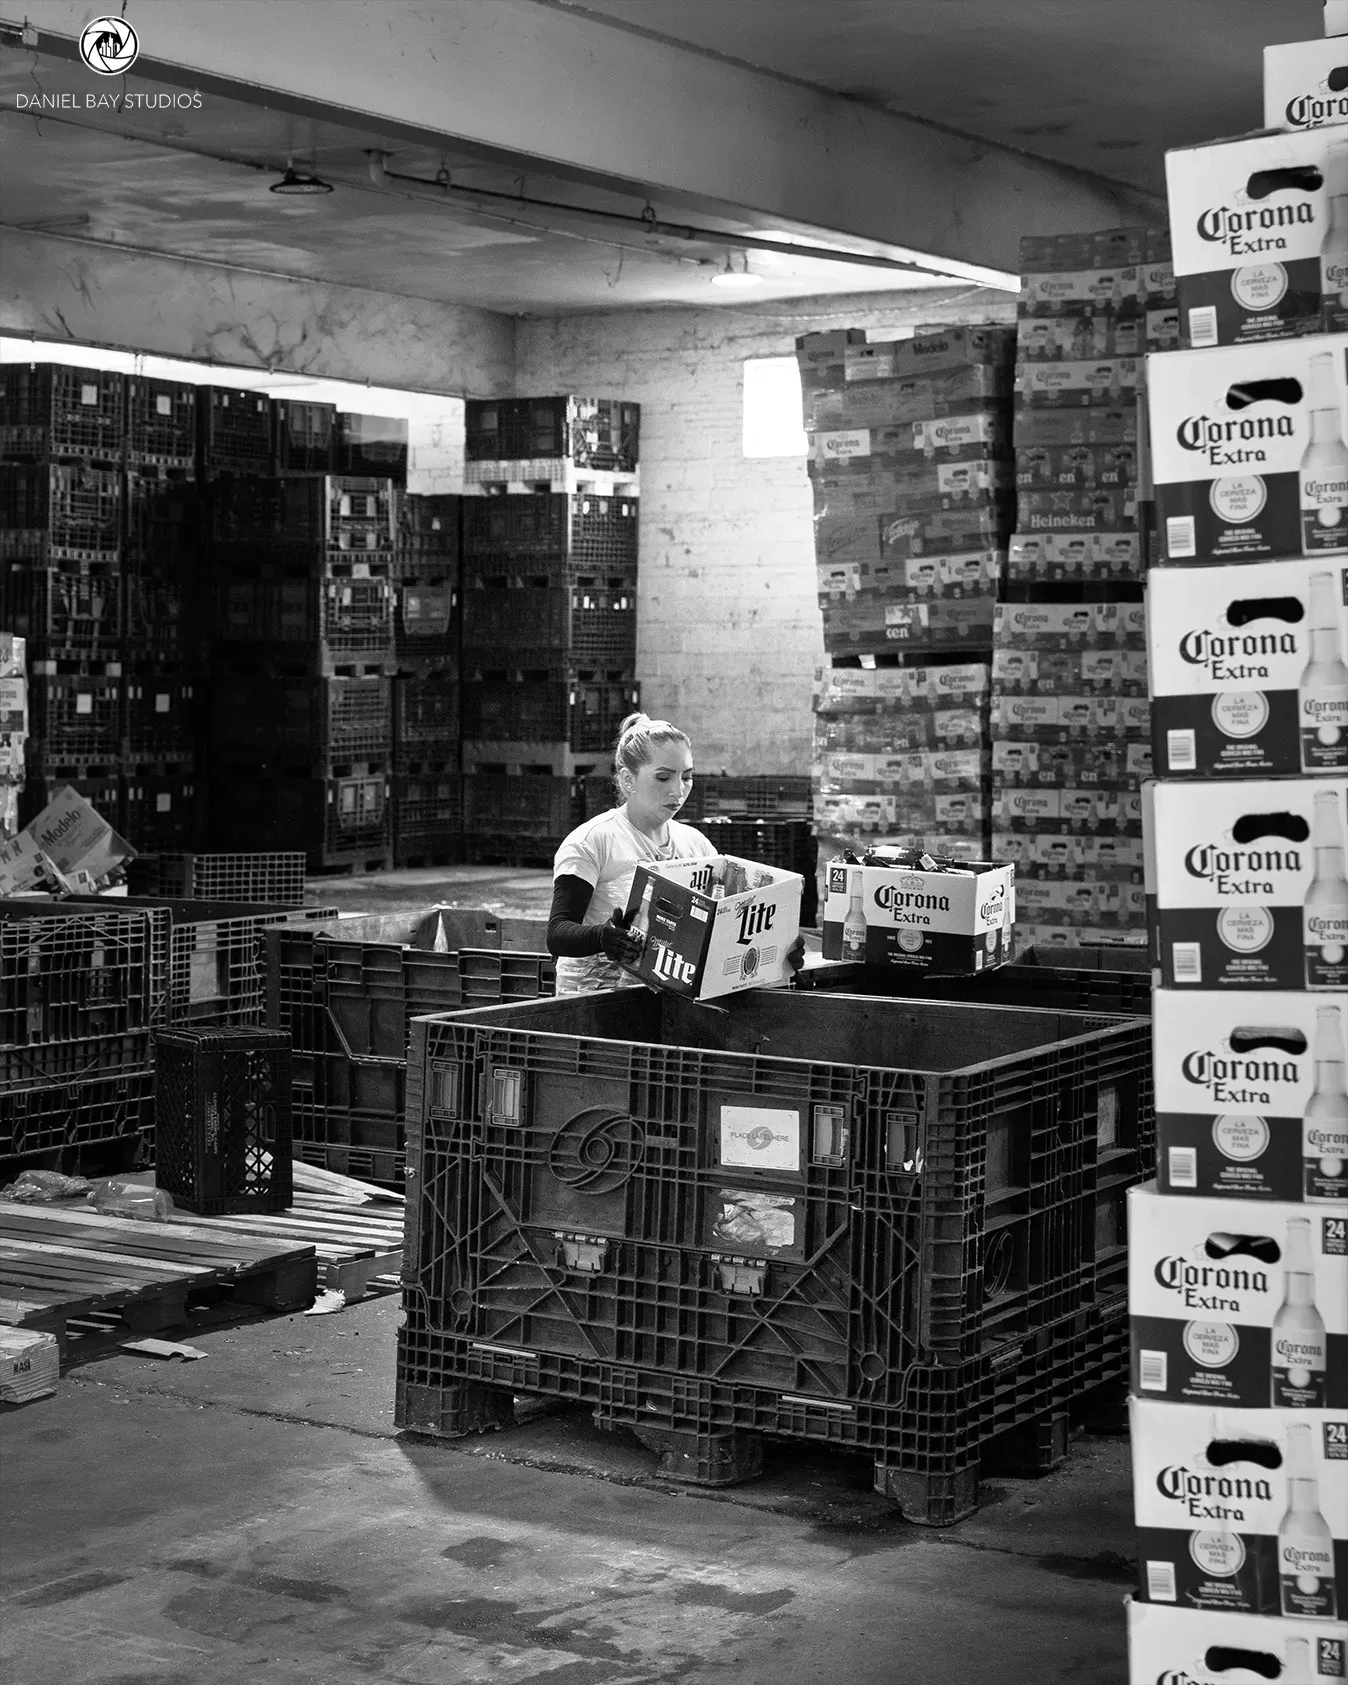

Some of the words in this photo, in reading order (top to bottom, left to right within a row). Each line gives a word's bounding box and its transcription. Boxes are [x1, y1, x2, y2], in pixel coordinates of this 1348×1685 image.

[1197, 202, 1315, 244] Corona
[1229, 235, 1288, 255] Extra
[826, 438, 860, 450] Corona
[1176, 415, 1295, 454] Corona
[1209, 445, 1267, 466] Extra
[1304, 480, 1348, 497] Coron
[1030, 513, 1096, 529] Heineken
[1014, 612, 1049, 624] Corona
[1178, 629, 1298, 668] Corona
[939, 674, 975, 686] Corona
[1211, 660, 1270, 680] Extra
[1014, 796, 1048, 808] Corona
[41, 808, 82, 846] Modelo
[1184, 843, 1303, 882] Corona
[832, 869, 844, 882] 24
[1216, 874, 1275, 895] Extra
[691, 895, 699, 905] 24
[874, 884, 950, 911] Corona
[735, 902, 776, 946] Lite
[893, 907, 931, 925] Extra
[651, 943, 697, 986] Lite
[1181, 1050, 1300, 1089] Corona
[1213, 1081, 1271, 1104] Extra
[730, 1131, 750, 1139] PLACE
[752, 1133, 771, 1141] LABEL
[772, 1134, 789, 1143] HERE
[1326, 1220, 1346, 1239] 24
[1154, 1255, 1269, 1294] Corona
[1185, 1288, 1241, 1312] Extra
[1276, 1339, 1323, 1357] Corona
[1327, 1424, 1348, 1443] 24
[1156, 1465, 1274, 1504] Corona
[1189, 1498, 1245, 1522] Extra
[1283, 1546, 1331, 1563] Corona
[1321, 1641, 1342, 1660] 24
